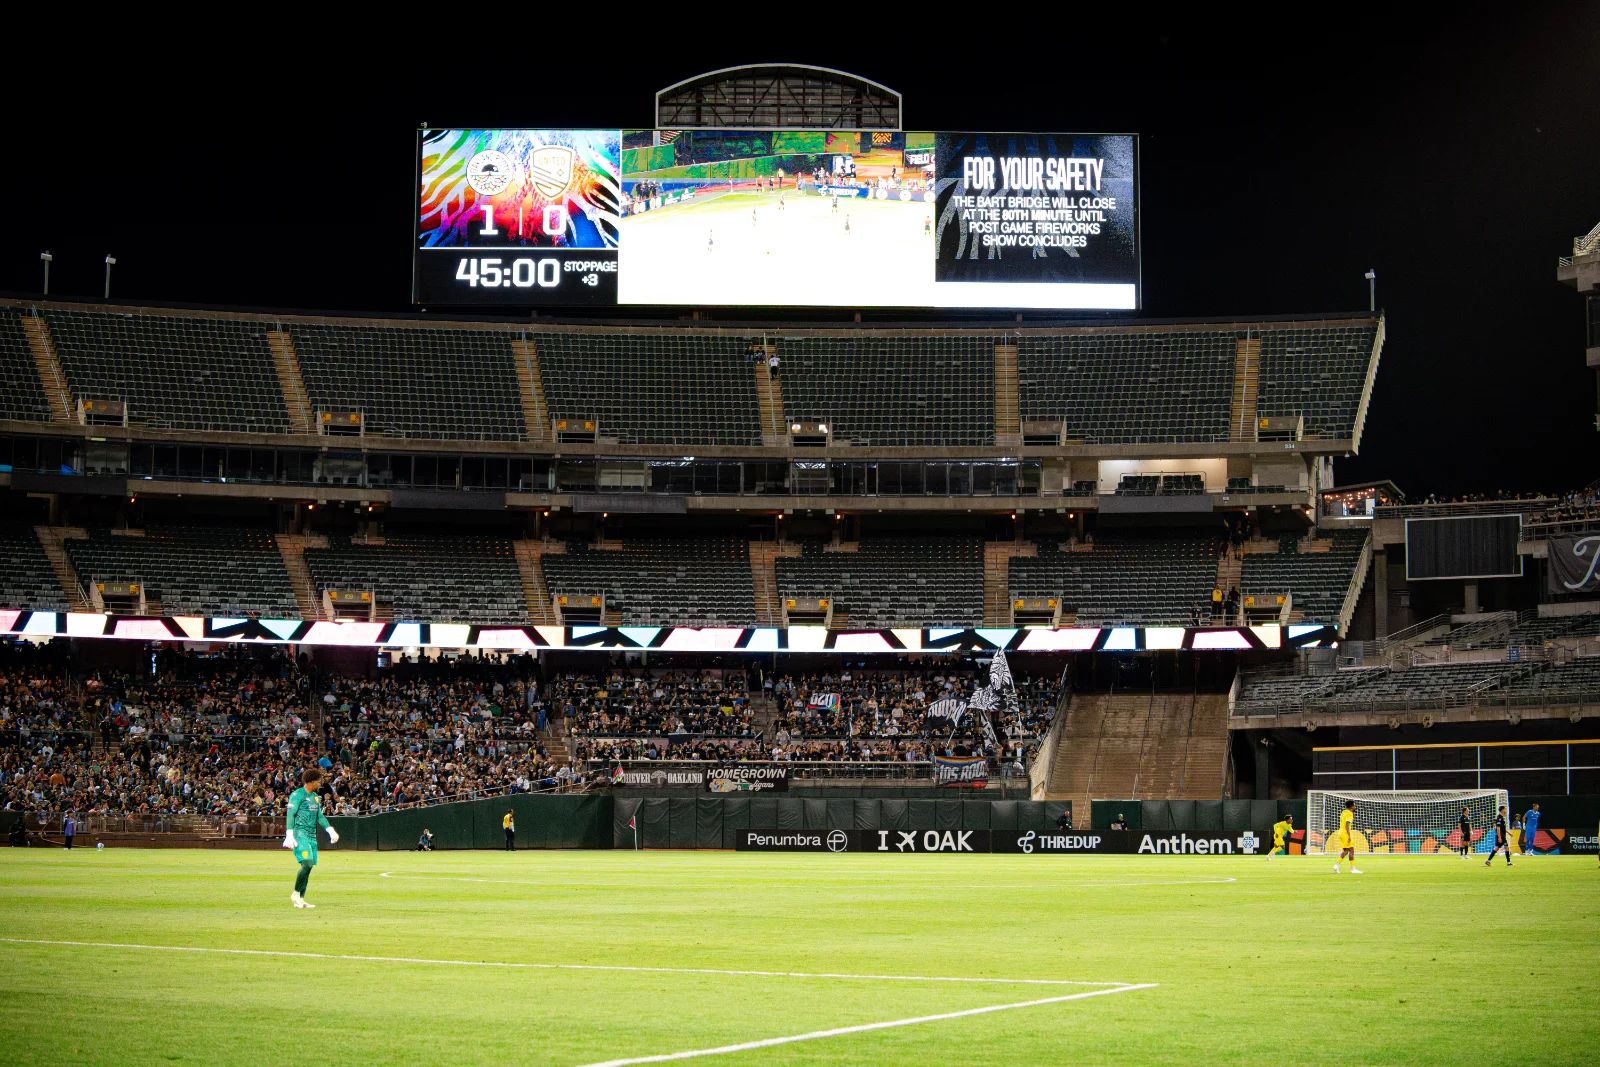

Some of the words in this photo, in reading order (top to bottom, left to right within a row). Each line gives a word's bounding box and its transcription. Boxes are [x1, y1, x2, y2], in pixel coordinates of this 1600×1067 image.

[538, 156, 565, 165] UNITED
[963, 156, 995, 190] FOR
[1000, 157, 1044, 190] YOUR
[1046, 157, 1104, 191] SAFETY
[953, 196, 975, 208] THE
[977, 196, 1006, 208] BART
[1008, 197, 1050, 208] BRIDGE
[1052, 197, 1078, 209] WILL
[1079, 198, 1116, 209] CLOSE
[479, 204, 499, 236] 1
[542, 204, 567, 236] 0
[963, 209, 979, 220] AT
[979, 209, 1001, 221] THE
[1002, 210, 1029, 221] 80TH
[1031, 210, 1073, 221] MINUTE
[1075, 210, 1107, 222] UNTIL
[969, 221, 1000, 233] POST
[1001, 222, 1033, 234] GAME
[1036, 223, 1101, 235] FIREWORKS
[983, 235, 1017, 247] SHOW
[1019, 235, 1087, 247] CONCLUDES
[455, 258, 561, 288] 45:00
[563, 261, 618, 272] STOPPAGE
[581, 273, 599, 287] +3
[621, 772, 651, 784] OREVER
[667, 772, 703, 784] OAKLAND
[706, 768, 787, 779] HOMEGROWN
[747, 832, 822, 847] Penumbra
[877, 830, 889, 850] I
[923, 830, 974, 851] OAK
[1038, 835, 1101, 849] THREDUP
[1138, 833, 1232, 854] Anthem
